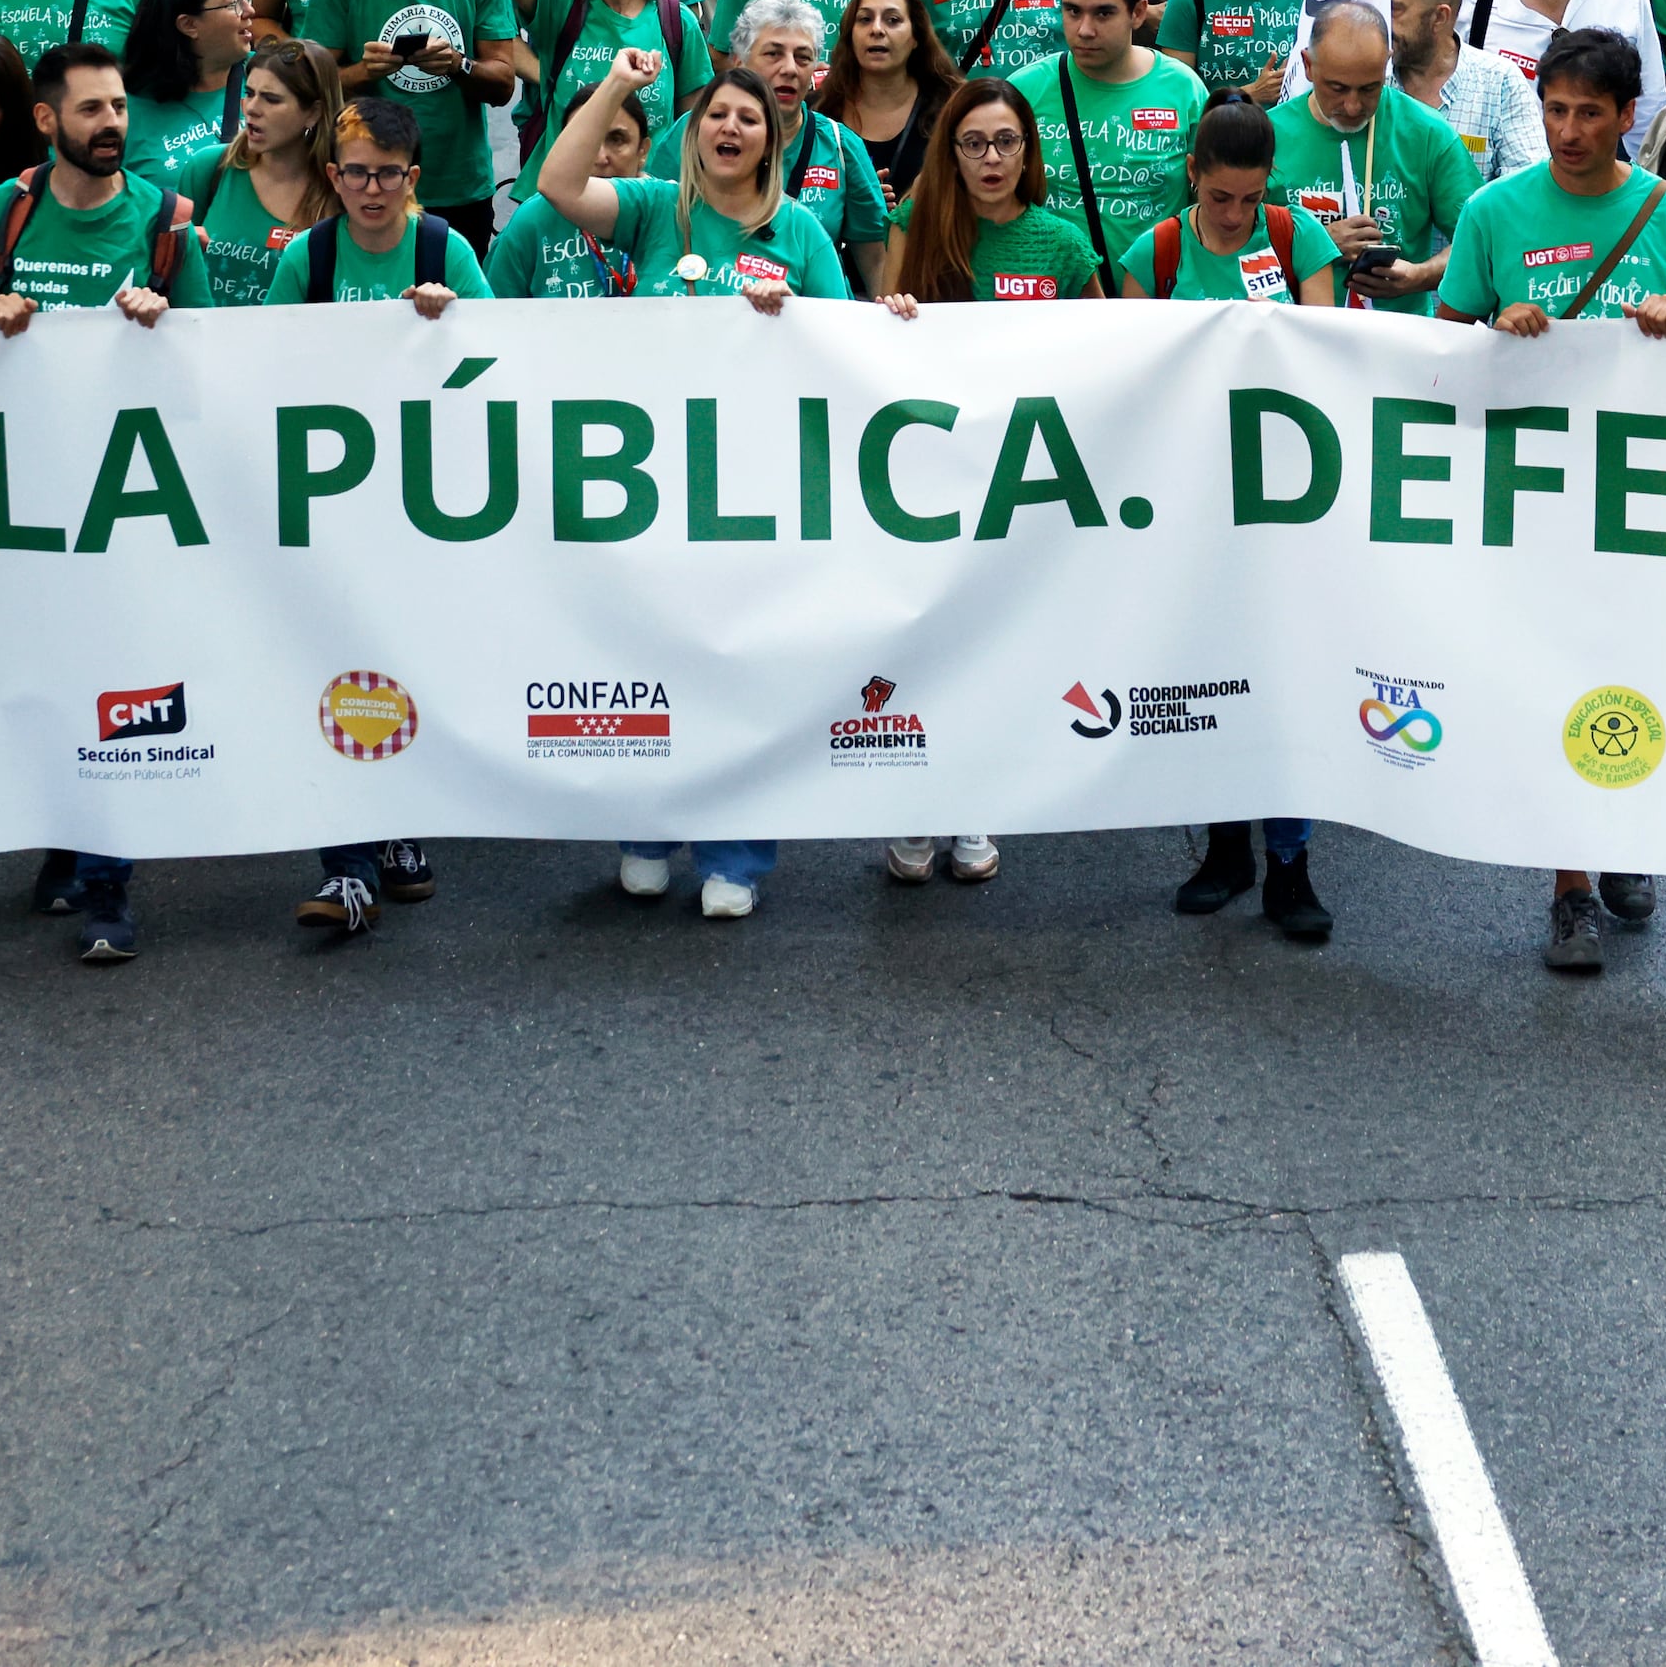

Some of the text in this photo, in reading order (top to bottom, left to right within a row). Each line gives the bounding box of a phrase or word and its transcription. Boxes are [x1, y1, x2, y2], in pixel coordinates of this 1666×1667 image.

[381, 4, 461, 44] PRIMARIA EXISTE
[1135, 111, 1176, 122] CCOO
[13, 257, 112, 278] Queremos FP
[1524, 249, 1554, 267] UGT
[12, 279, 70, 294] de todas
[995, 275, 1037, 296] UGT
[1248, 270, 1286, 292] STEM
[275, 357, 1154, 548] PÚBLICA.
[526, 681, 671, 710] CONFAPA
[1129, 678, 1251, 704] COORDINADORA
[1372, 681, 1423, 710] TEA
[108, 697, 174, 727] CNT
[335, 706, 403, 721] UNIVERSAL
[340, 697, 397, 711] COMEDOR
[1130, 701, 1192, 719] JUVENIL
[830, 713, 925, 736] CONTRA
[1130, 714, 1218, 736] SOCIALISTA
[1568, 690, 1662, 743] EDUCACIÓN ESPECIAL
[830, 733, 927, 750] CORRIENTE
[77, 743, 215, 764] Sección Sindical
[527, 748, 671, 759] DE LA COMUNIDAD DE MADRID
